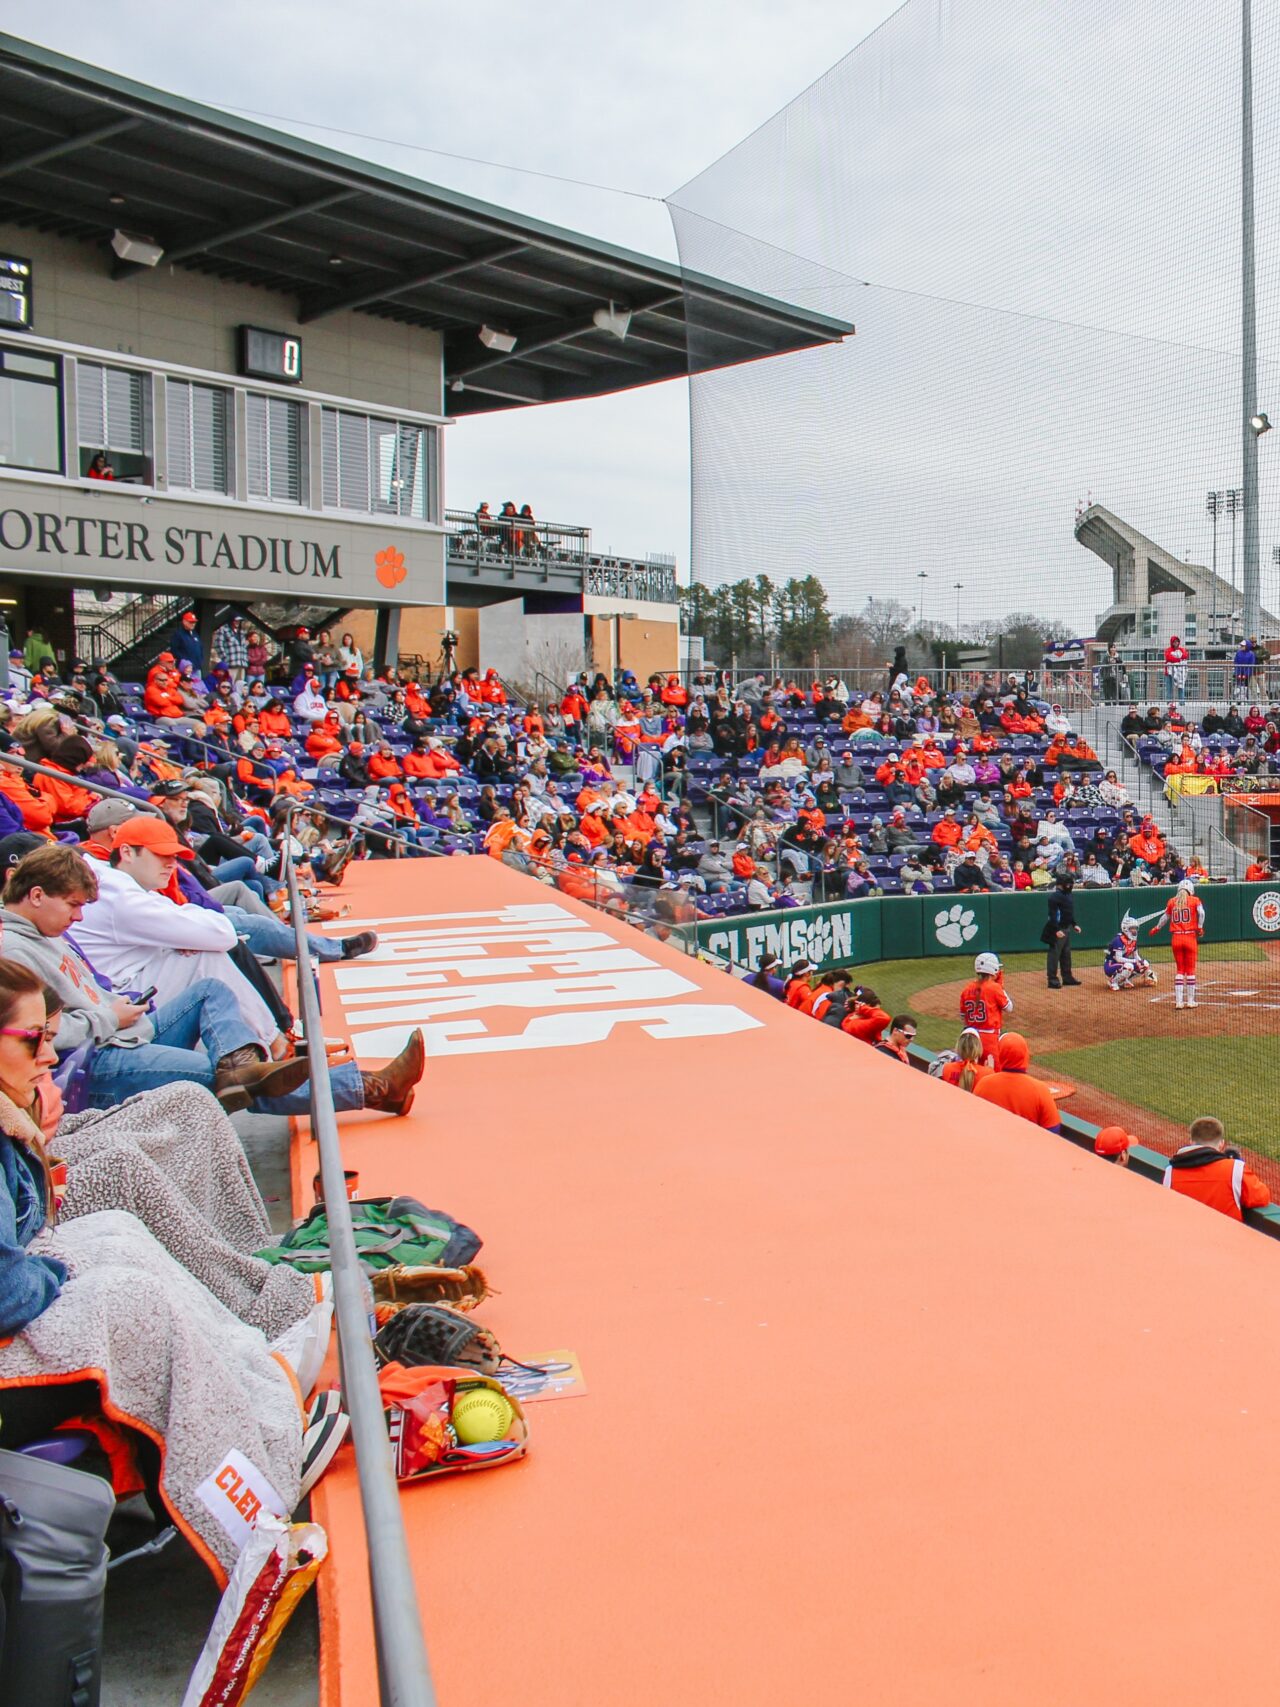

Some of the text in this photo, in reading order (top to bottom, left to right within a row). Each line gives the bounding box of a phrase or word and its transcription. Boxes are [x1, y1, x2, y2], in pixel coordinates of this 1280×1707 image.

[284, 340, 299, 376] 0
[0, 508, 342, 579] ORTER STADIUM
[1172, 908, 1191, 924] 00
[964, 999, 987, 1022] 23
